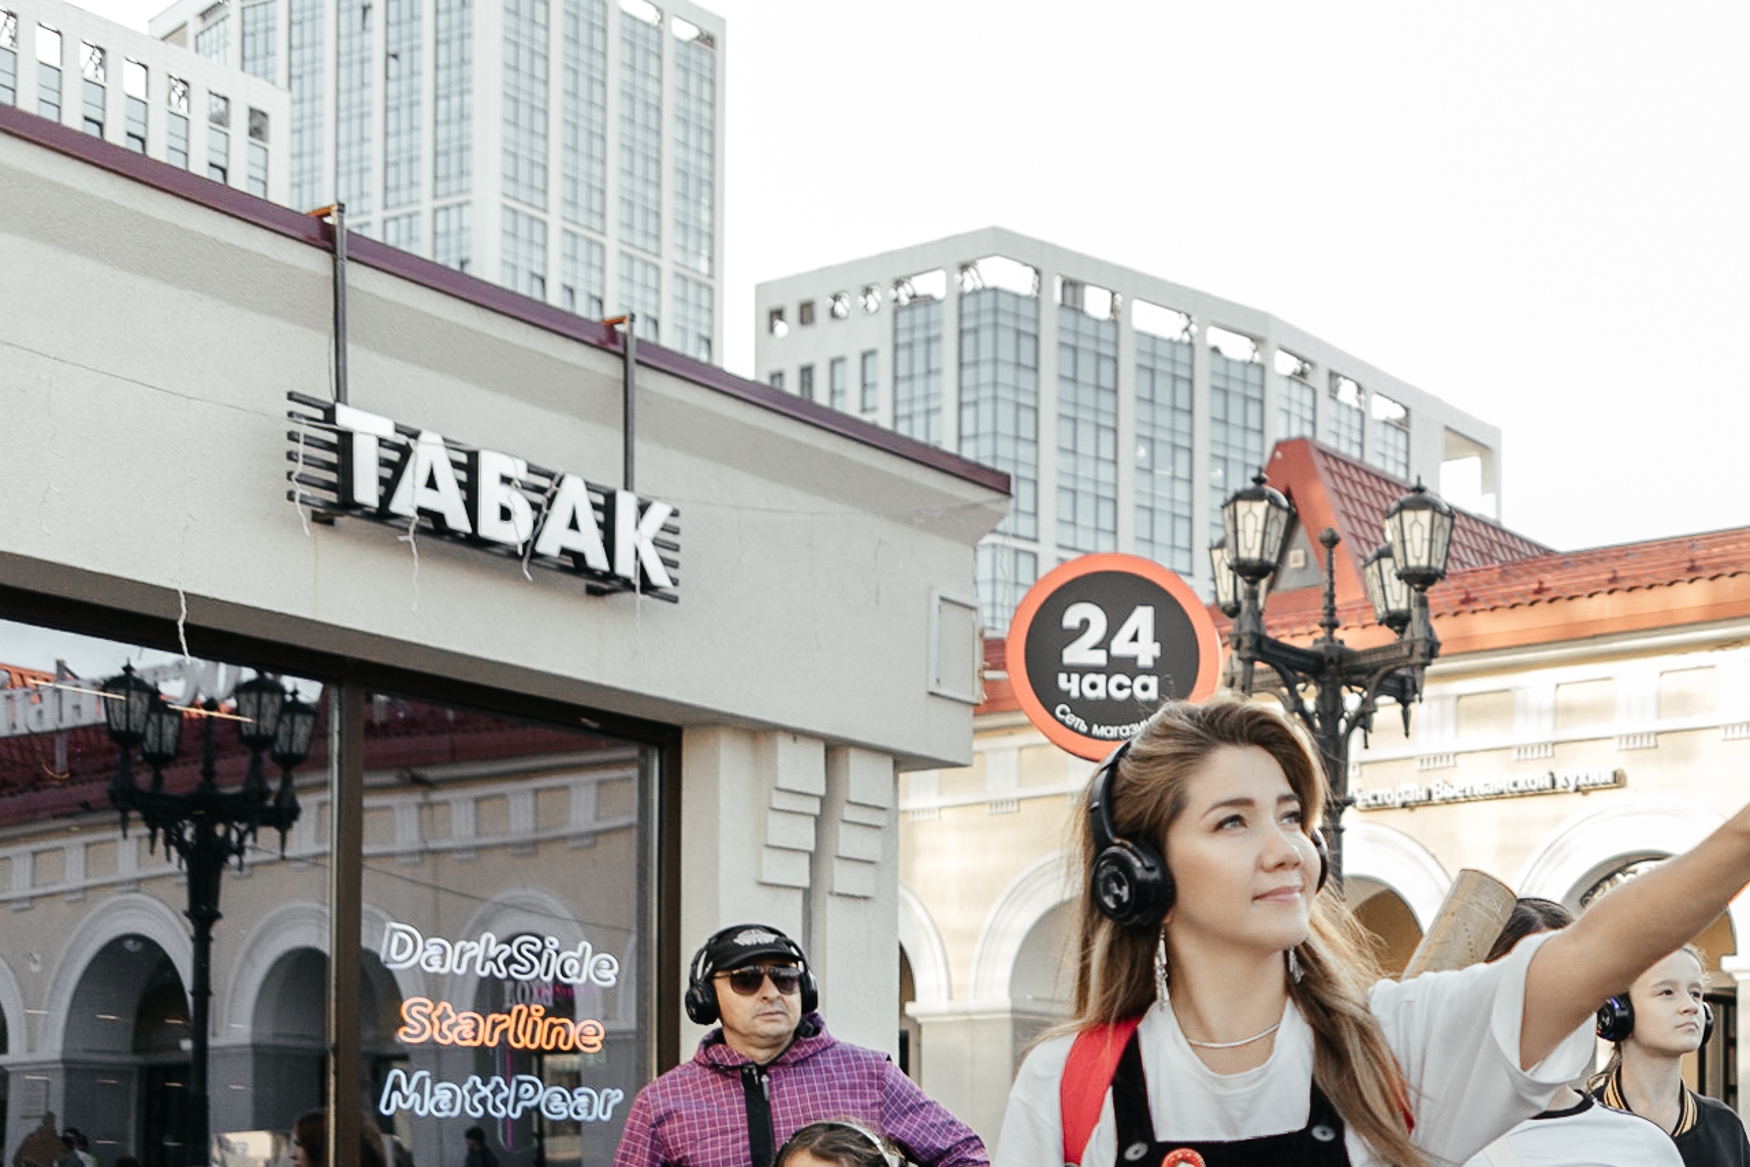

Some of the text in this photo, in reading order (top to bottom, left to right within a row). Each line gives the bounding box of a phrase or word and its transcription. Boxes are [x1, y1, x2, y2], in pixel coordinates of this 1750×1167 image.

[334, 402, 673, 588] ТАБАК
[1061, 601, 1162, 669] 24
[1057, 672, 1159, 701] часа
[1054, 703, 1150, 739] Сеть магази
[380, 921, 619, 987] DarkSide
[398, 996, 606, 1054] Starline
[378, 1067, 625, 1122] MattPear
